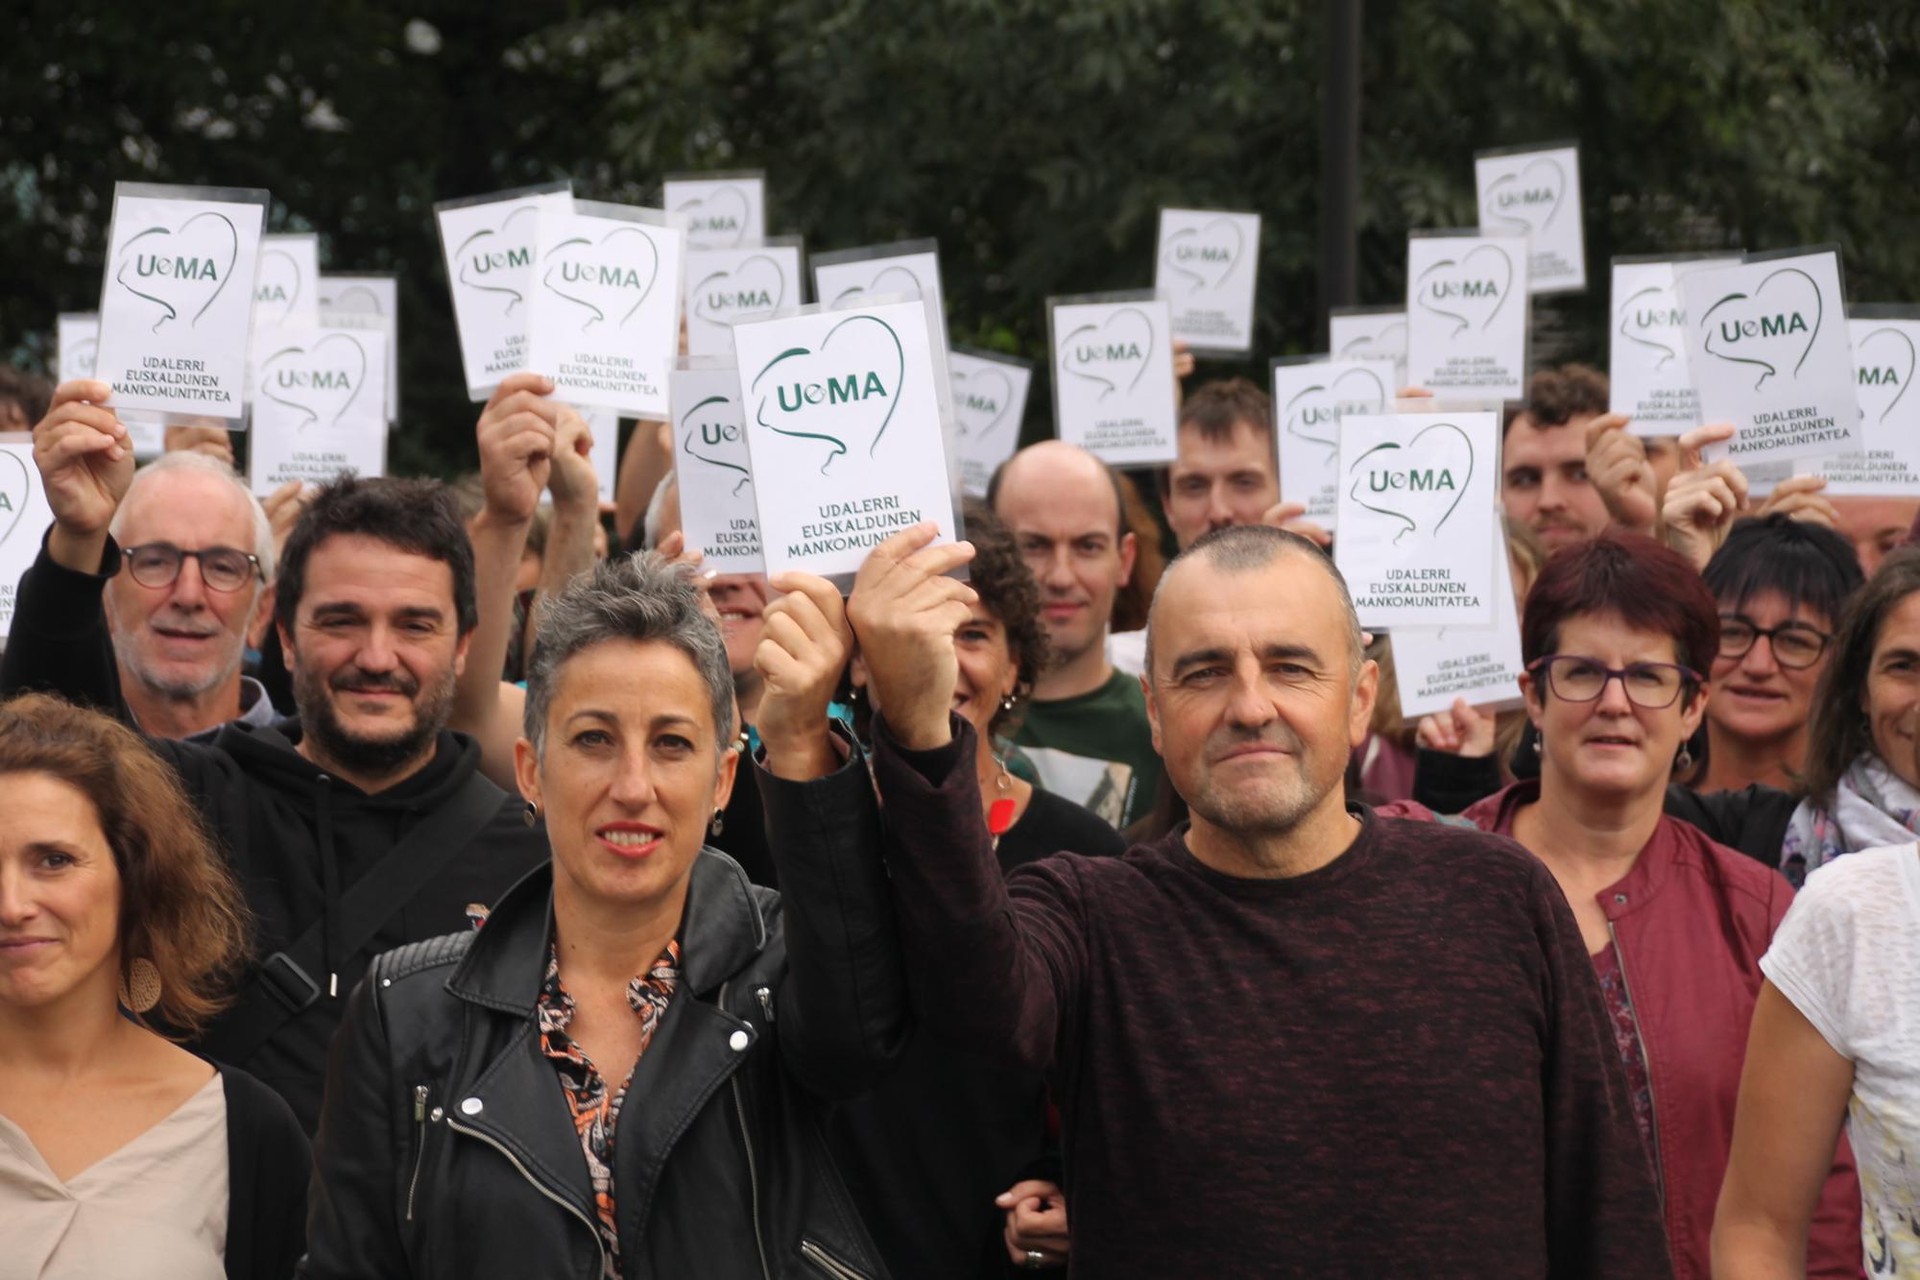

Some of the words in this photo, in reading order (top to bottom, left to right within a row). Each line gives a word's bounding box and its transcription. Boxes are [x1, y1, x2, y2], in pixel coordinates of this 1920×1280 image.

[473, 246, 530, 274] UeM
[1636, 308, 1687, 328] UeM
[142, 357, 205, 372] UDALERRI
[574, 353, 633, 368] UDALERRI
[125, 370, 219, 387] EUSKALDUNEN
[559, 364, 646, 381] EUSKALDUNEN
[1858, 366, 1899, 386] MA
[111, 383, 232, 403] MANKOMUNITATEA
[1753, 406, 1817, 425] UDALERRI
[1739, 417, 1834, 440] EUSKALDUNEN
[1728, 430, 1850, 455] MANKOMUNITATEA
[819, 495, 900, 519] UDALERRI
[802, 510, 921, 539] EUSKALDUNEN
[1386, 569, 1451, 581] UDALERRI
[1370, 583, 1466, 595] EUSKALDUNEN
[1356, 596, 1480, 608] MANKOMUNITATEA
